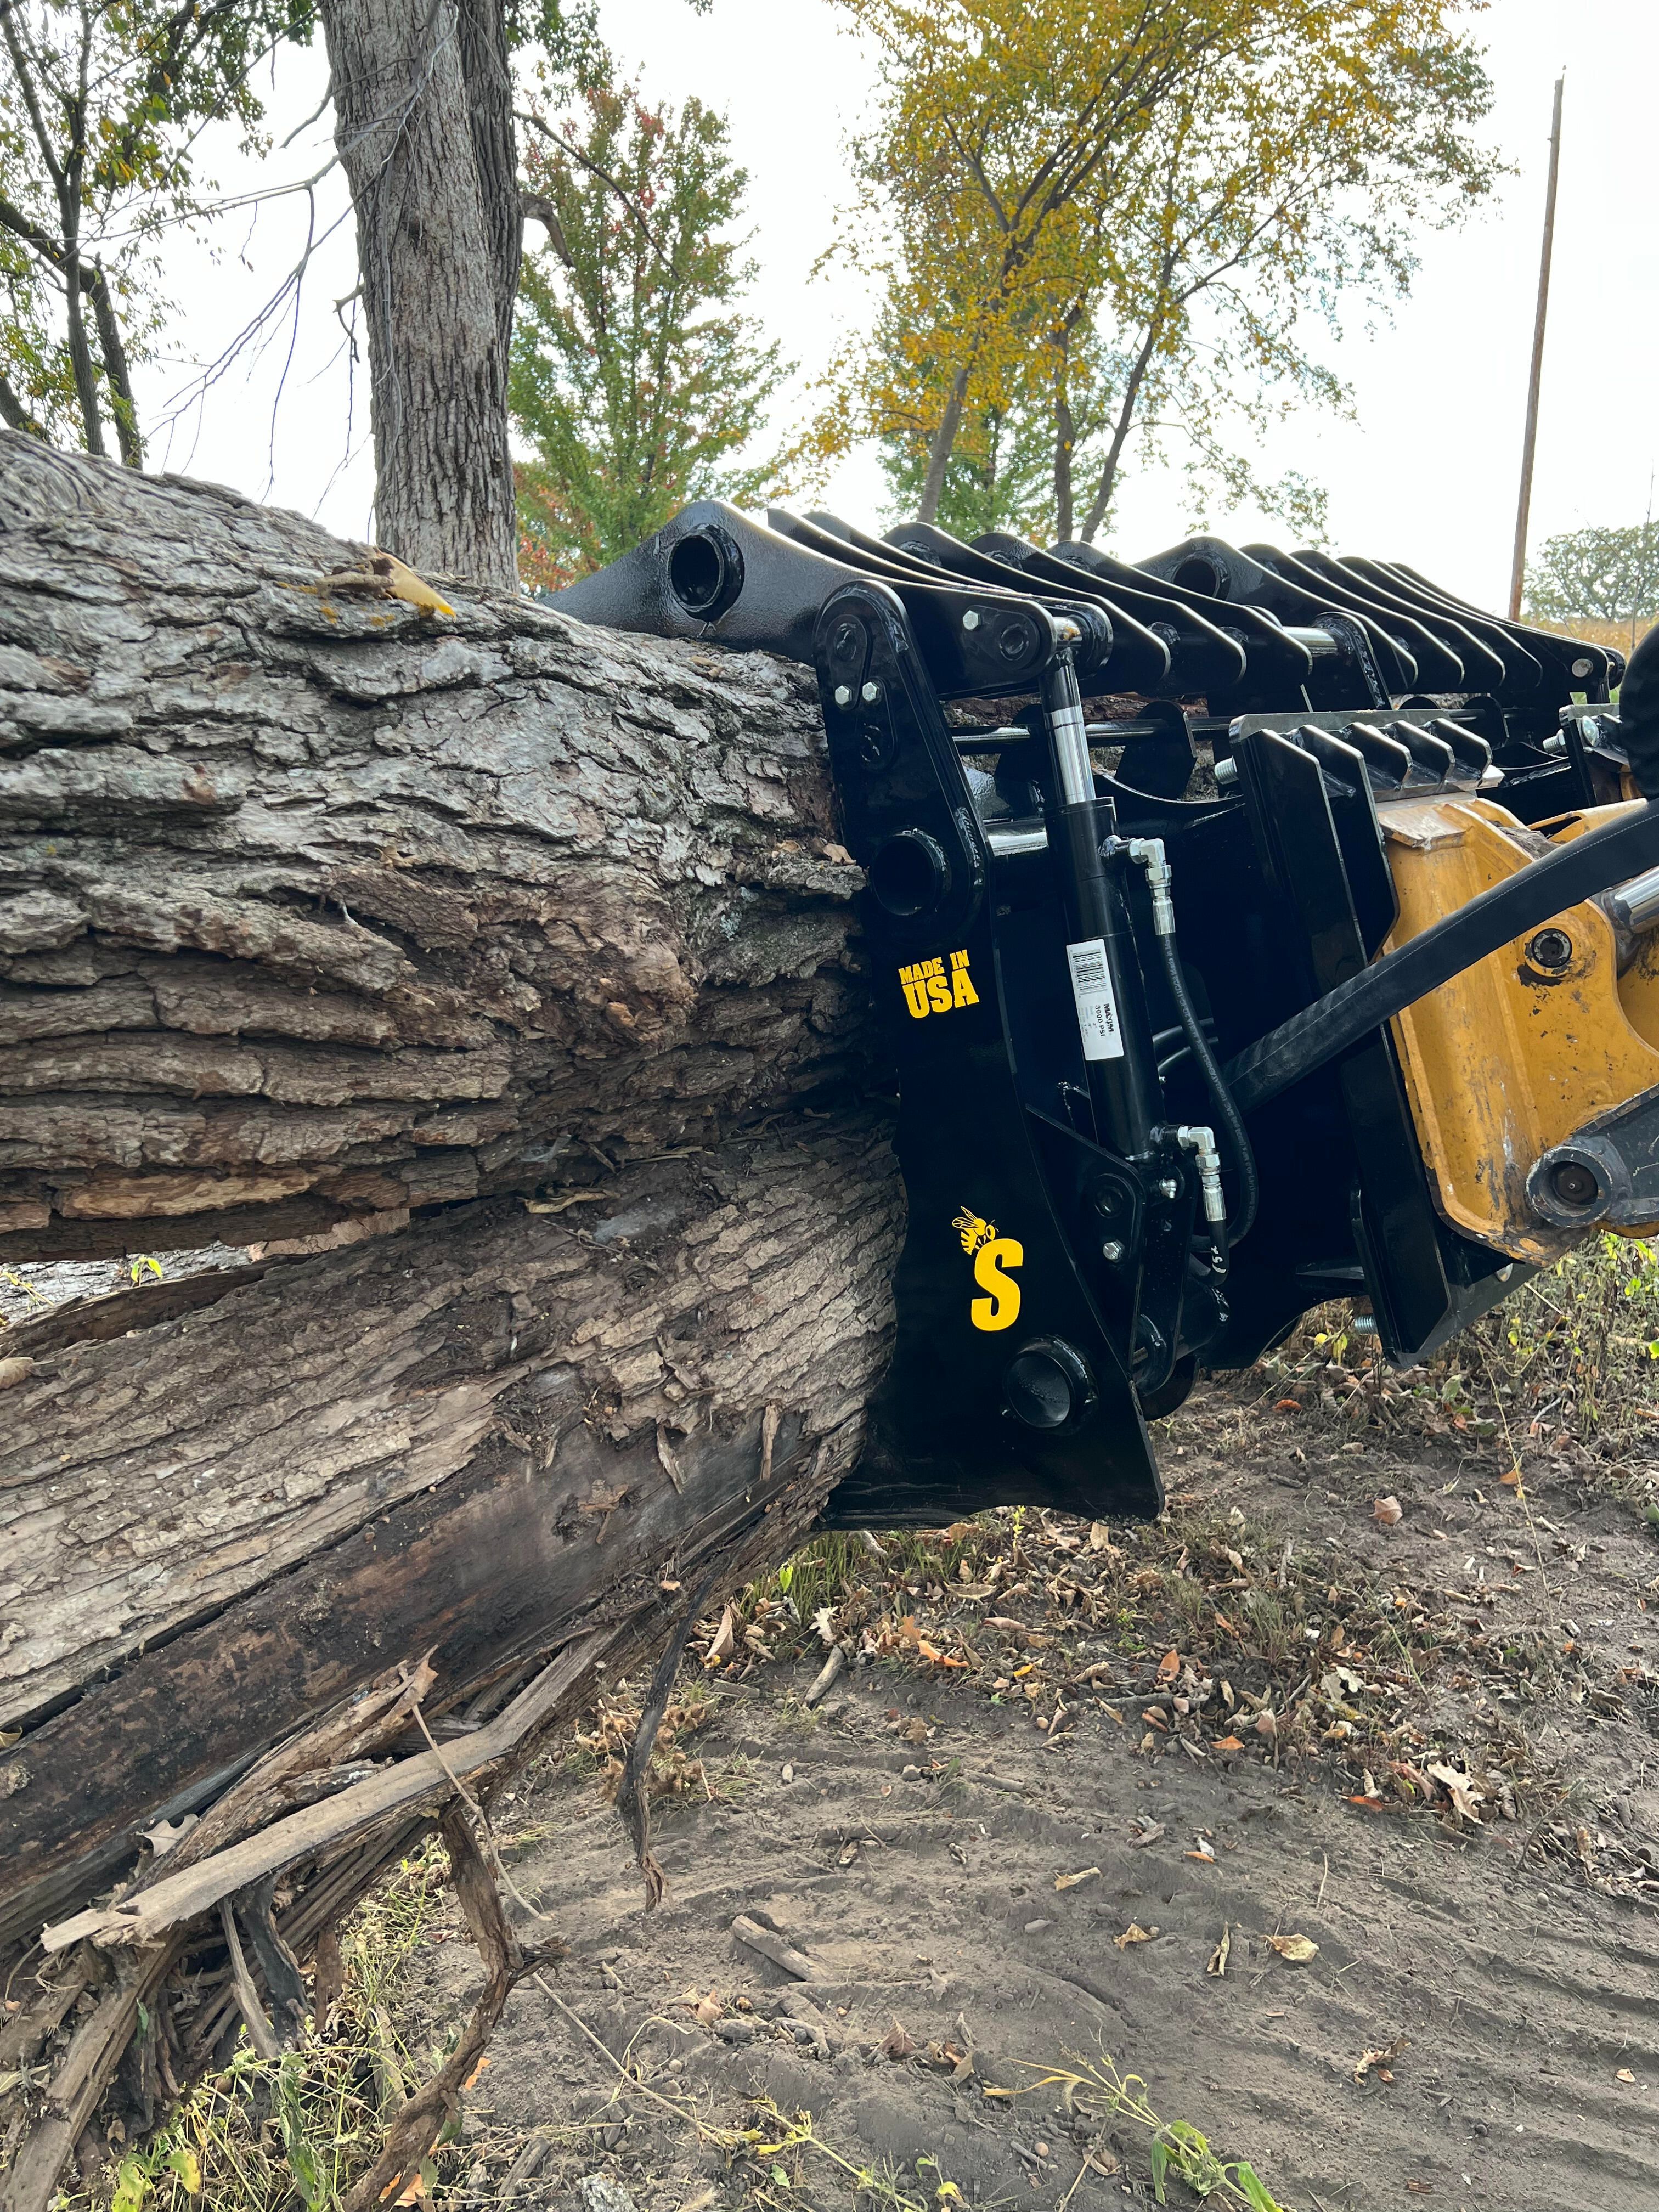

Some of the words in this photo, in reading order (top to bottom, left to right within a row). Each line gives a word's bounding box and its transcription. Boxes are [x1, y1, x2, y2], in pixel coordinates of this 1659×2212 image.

[898, 957, 945, 984] MADE
[950, 949, 970, 970] IN
[902, 968, 979, 1019] USA
[1104, 1003, 1114, 1032] MAXIM
[971, 1238, 1023, 1331] S
